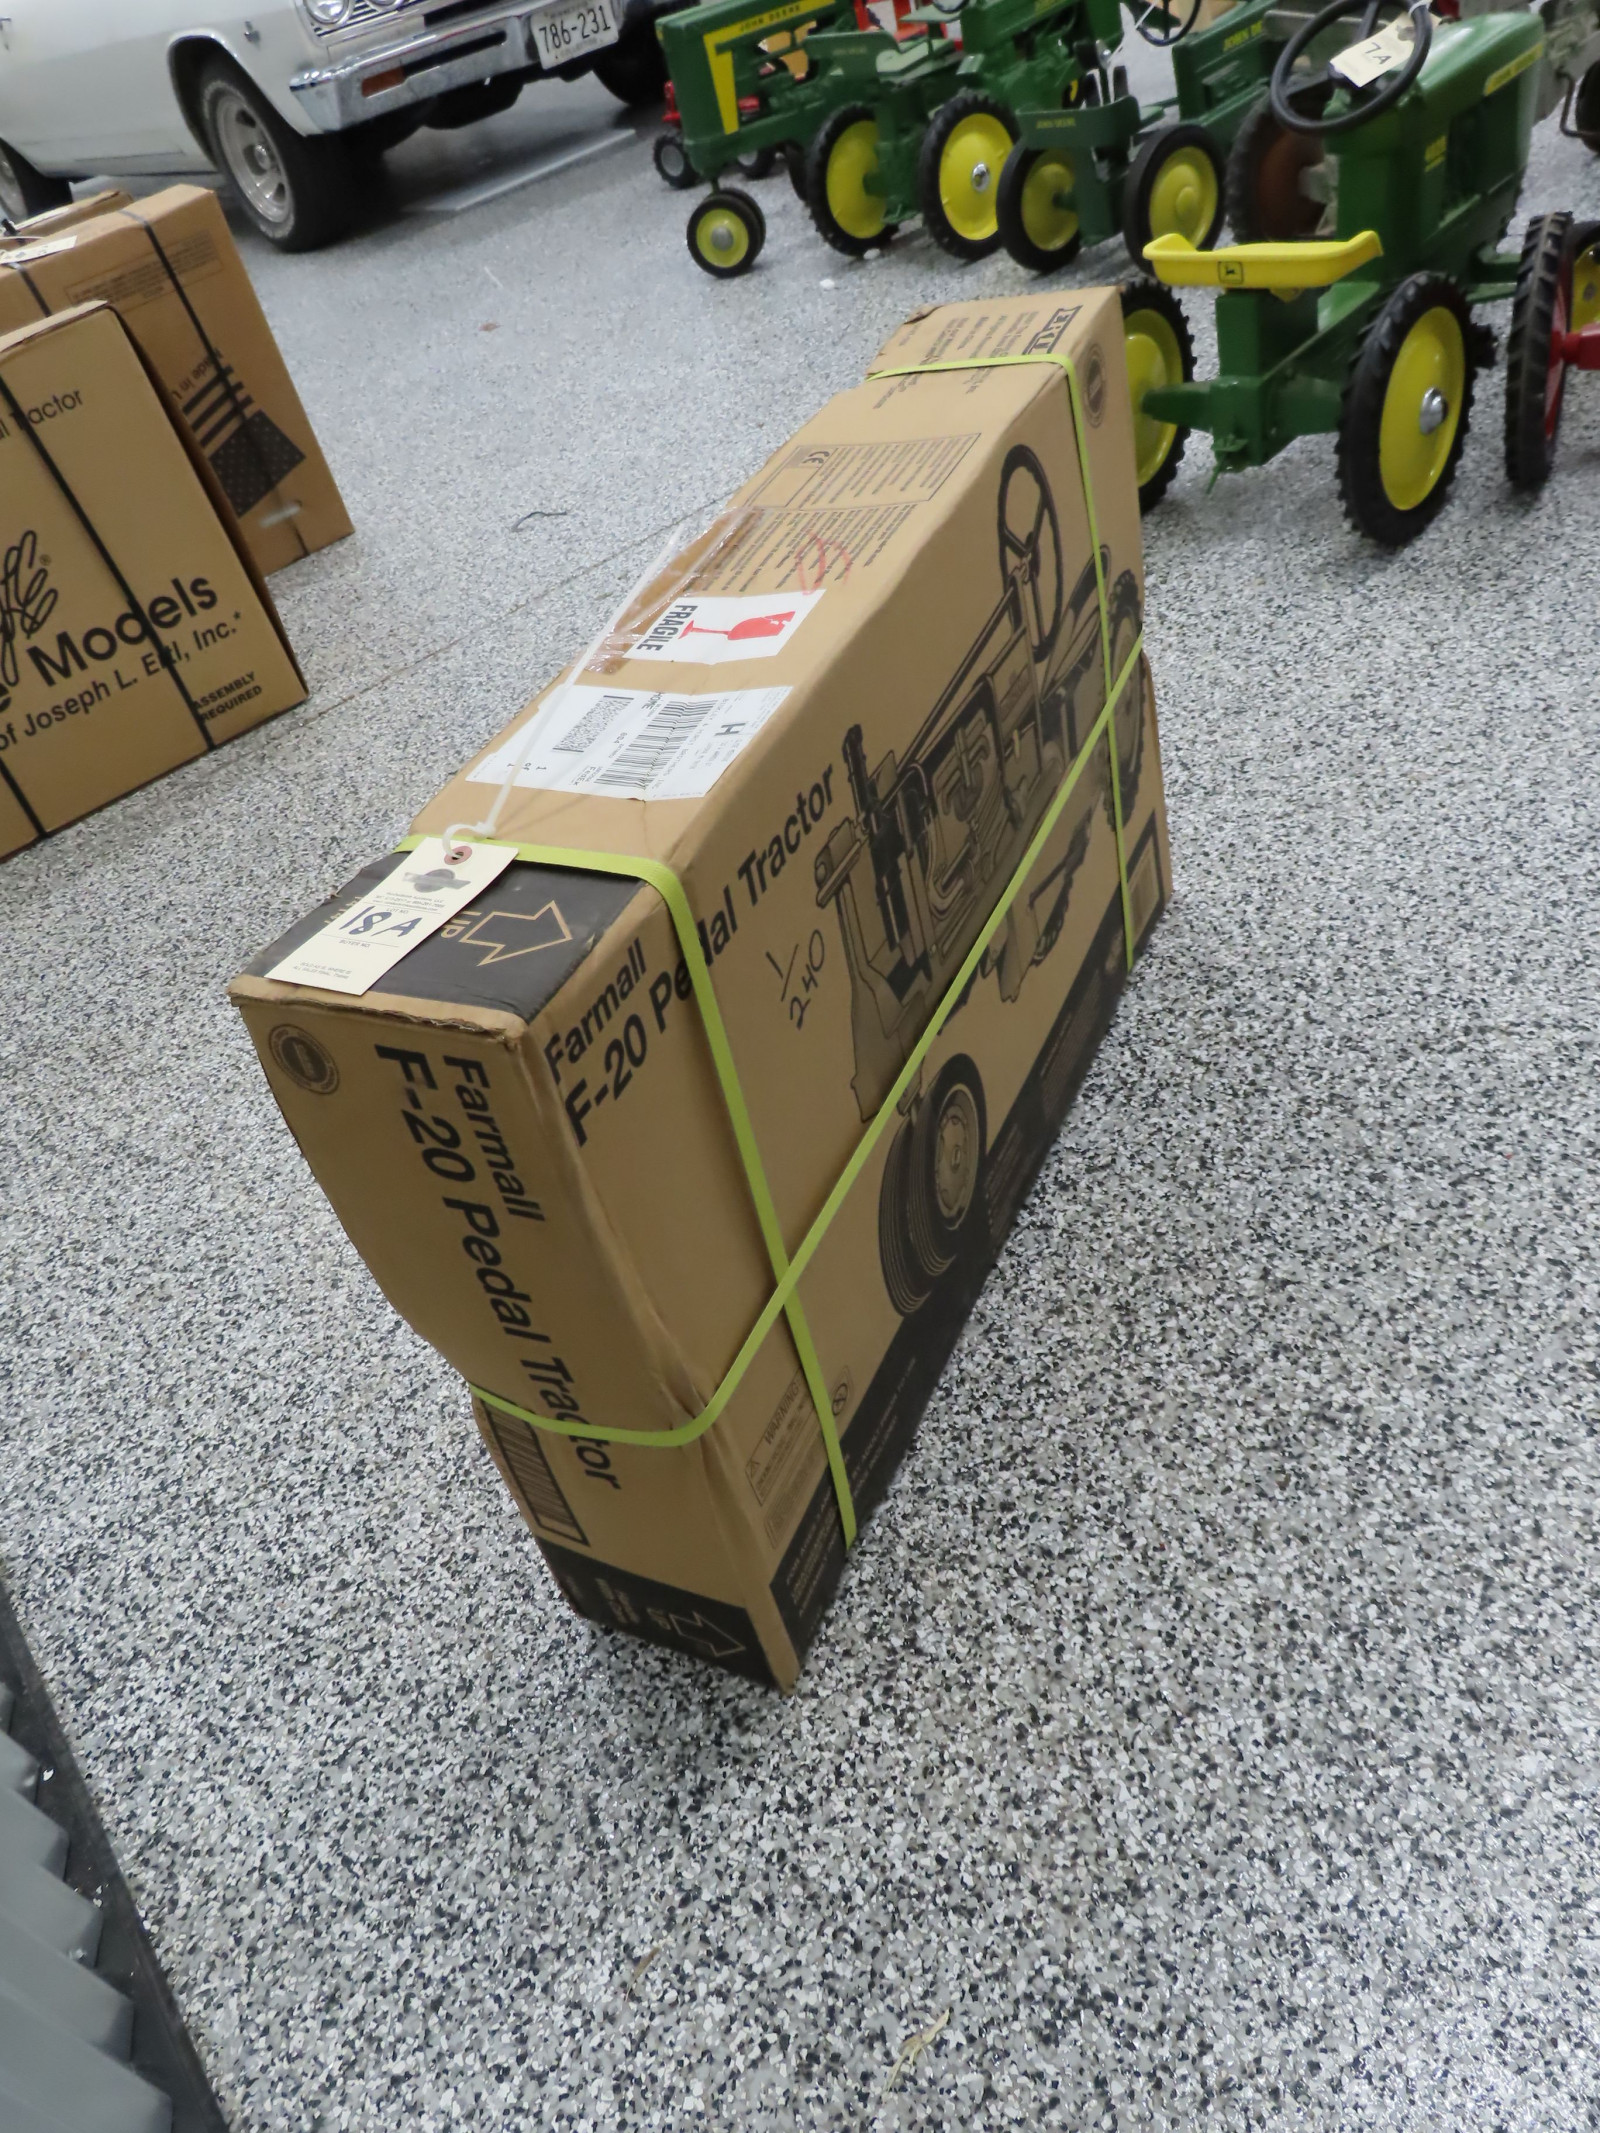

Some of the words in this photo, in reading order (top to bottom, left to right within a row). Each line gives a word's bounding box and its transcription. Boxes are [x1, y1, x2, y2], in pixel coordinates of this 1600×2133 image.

[538, 5, 612, 56] 786-231
[1360, 42, 1393, 66] 7A
[27, 576, 219, 687] Models
[636, 604, 699, 652] FRAGILE
[24, 681, 112, 737] Joseph
[113, 667, 139, 691] L.
[193, 670, 257, 711] ASSEMBLY
[199, 684, 263, 724] REQUIRED
[714, 722, 746, 737] H
[440, 910, 483, 939] UP
[564, 1011, 648, 1148] F-20
[737, 762, 834, 907] Tractor
[544, 936, 647, 1085] Farmall
[442, 1054, 546, 1223] Farmall
[373, 1043, 476, 1183] F-20
[441, 1196, 552, 1344] Pedal
